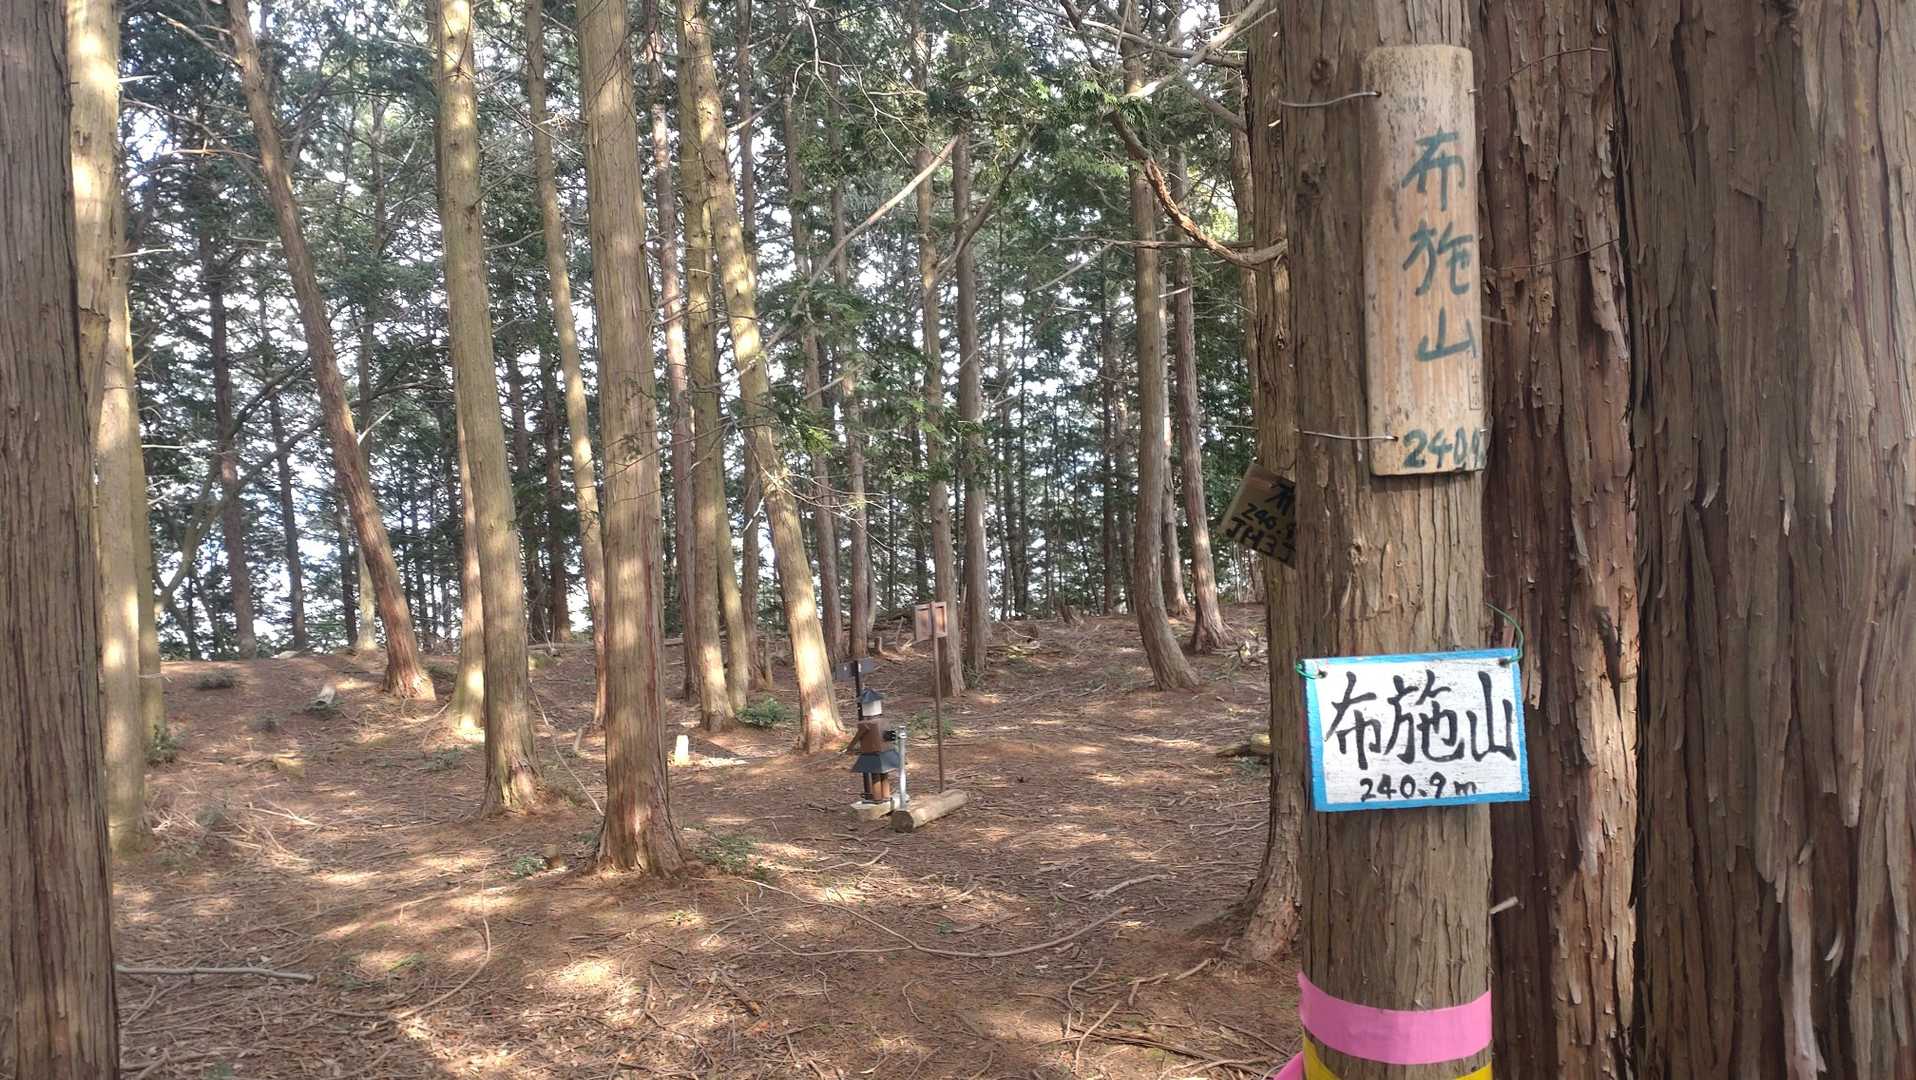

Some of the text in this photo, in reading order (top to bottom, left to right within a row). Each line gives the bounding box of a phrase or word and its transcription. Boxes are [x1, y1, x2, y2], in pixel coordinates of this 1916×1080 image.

[1401, 127, 1476, 361] 布施山
[1325, 669, 1516, 770] 布施山
